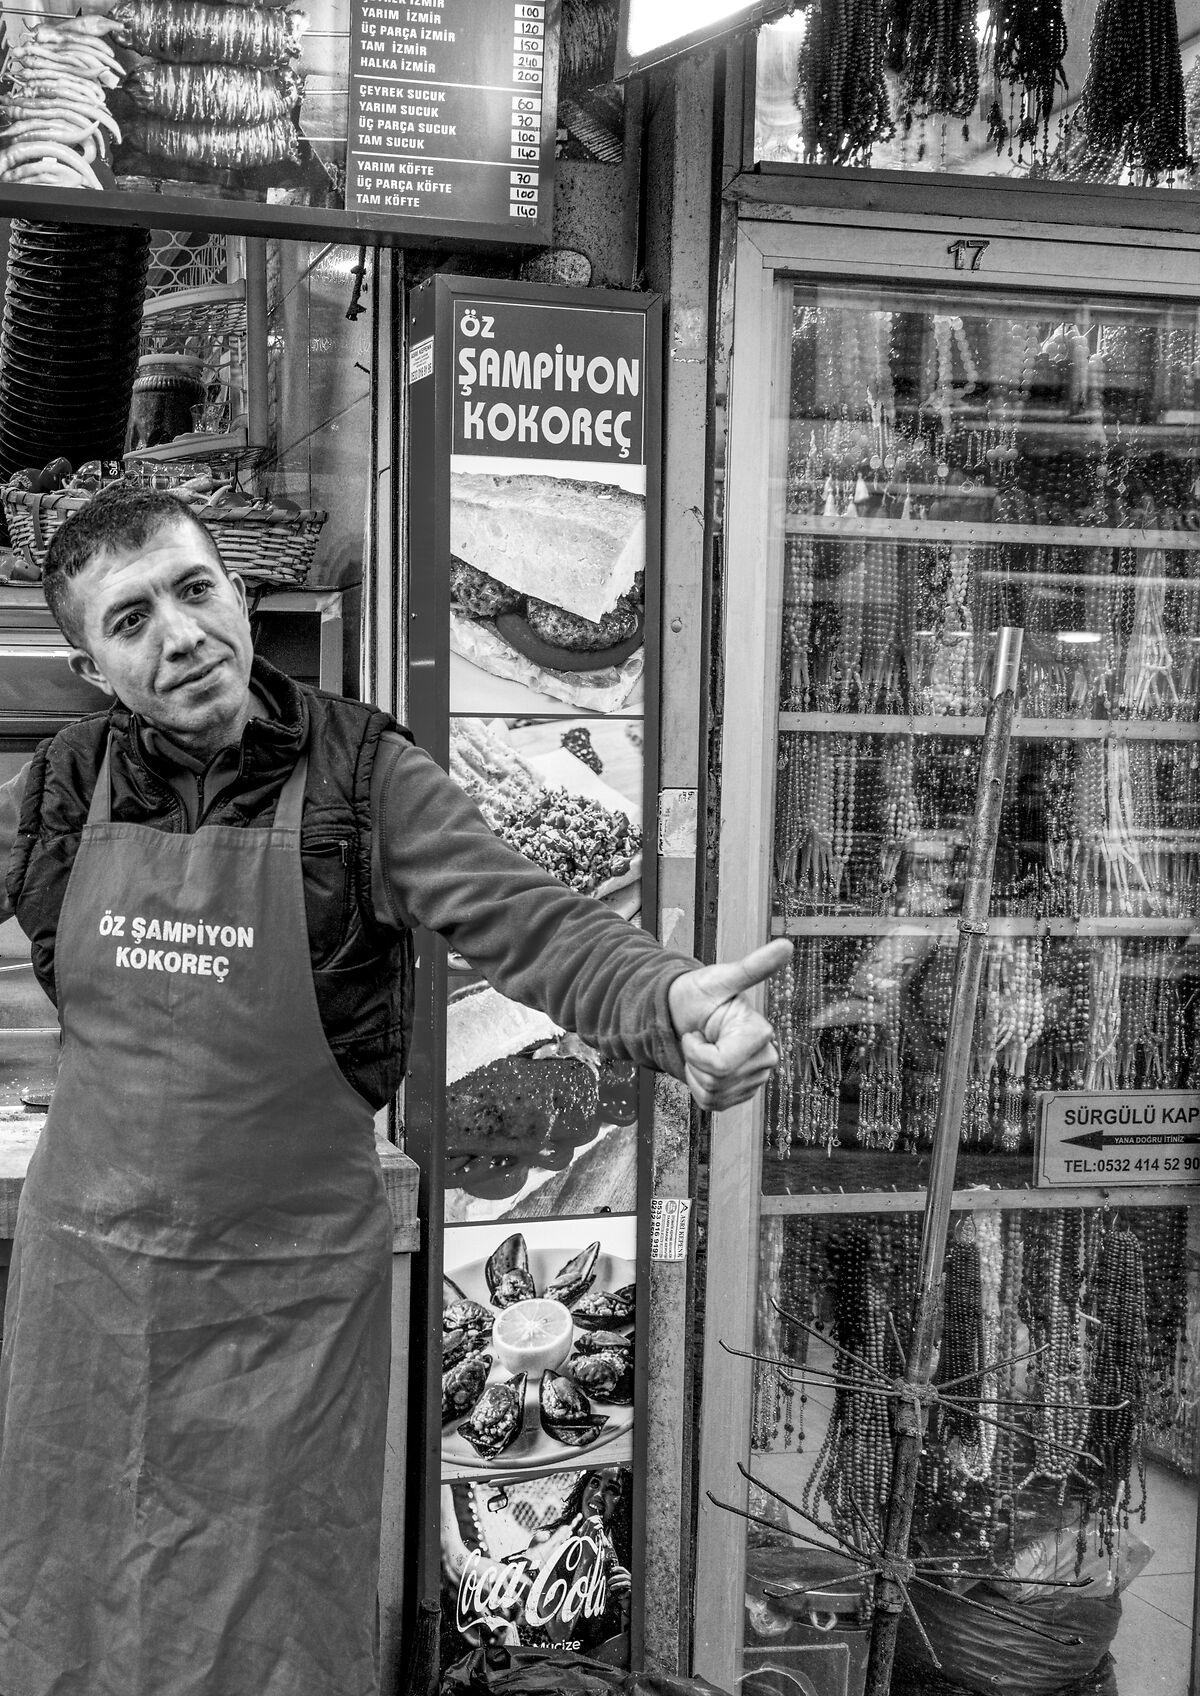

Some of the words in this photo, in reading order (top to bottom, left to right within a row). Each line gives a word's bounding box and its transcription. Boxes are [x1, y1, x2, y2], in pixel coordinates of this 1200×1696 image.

[362, 7, 399, 20] YARIM
[407, 9, 441, 24] İZMİR
[521, 23, 539, 35] 120
[521, 8, 539, 18] 100
[361, 40, 384, 52] TAM
[392, 41, 427, 56] İZMİR
[362, 21, 376, 36] ÜÇ
[380, 26, 417, 39] PARÇA
[421, 27, 455, 42] İZMİR
[521, 39, 538, 51] 150
[360, 57, 397, 70] HALKA
[401, 59, 435, 73] İZMİR
[518, 72, 539, 82] 200
[360, 85, 403, 98] ÇEYREK
[407, 89, 445, 102] SUCUK
[518, 101, 533, 110] 60
[359, 101, 396, 114] YARIM
[401, 105, 439, 118] SUCUK
[518, 117, 533, 127] 70
[359, 116, 372, 130] ÜÇ
[376, 119, 414, 133] PARÇA
[418, 123, 456, 135] SUCUK
[518, 133, 535, 142] 100
[358, 135, 382, 146] TAM
[386, 137, 424, 149] SUCUK
[518, 149, 536, 158] 140
[358, 161, 395, 173] YARIM
[399, 162, 434, 176] KÖFTE
[517, 174, 531, 183] 70
[357, 175, 371, 189] ÜÇ
[375, 178, 413, 192] PARÇA
[417, 179, 452, 194] KÖFTE
[516, 189, 534, 199] 100
[357, 194, 380, 206] TAM
[385, 195, 420, 208] KÖFTE
[517, 207, 536, 217] 140
[947, 240, 990, 270] 17
[460, 309, 495, 339] ÖZ
[458, 344, 639, 397] ŞAMPİYON
[464, 401, 632, 458] KOKOREÇ
[100, 910, 125, 937] ÖZ
[131, 917, 254, 948] ŞAMPİYON
[116, 946, 230, 983] KOKOREÇ
[1064, 1105, 1156, 1125] SÜRGÜLÜ
[1136, 1135, 1162, 1144] DOĞRU
[1164, 1135, 1185, 1143] İTİNİZ
[1064, 1159, 1130, 1172] TEL:0532
[1134, 1158, 1160, 1171] 414
[1164, 1158, 1179, 1170] 52
[1184, 1157, 1200, 1170] 90
